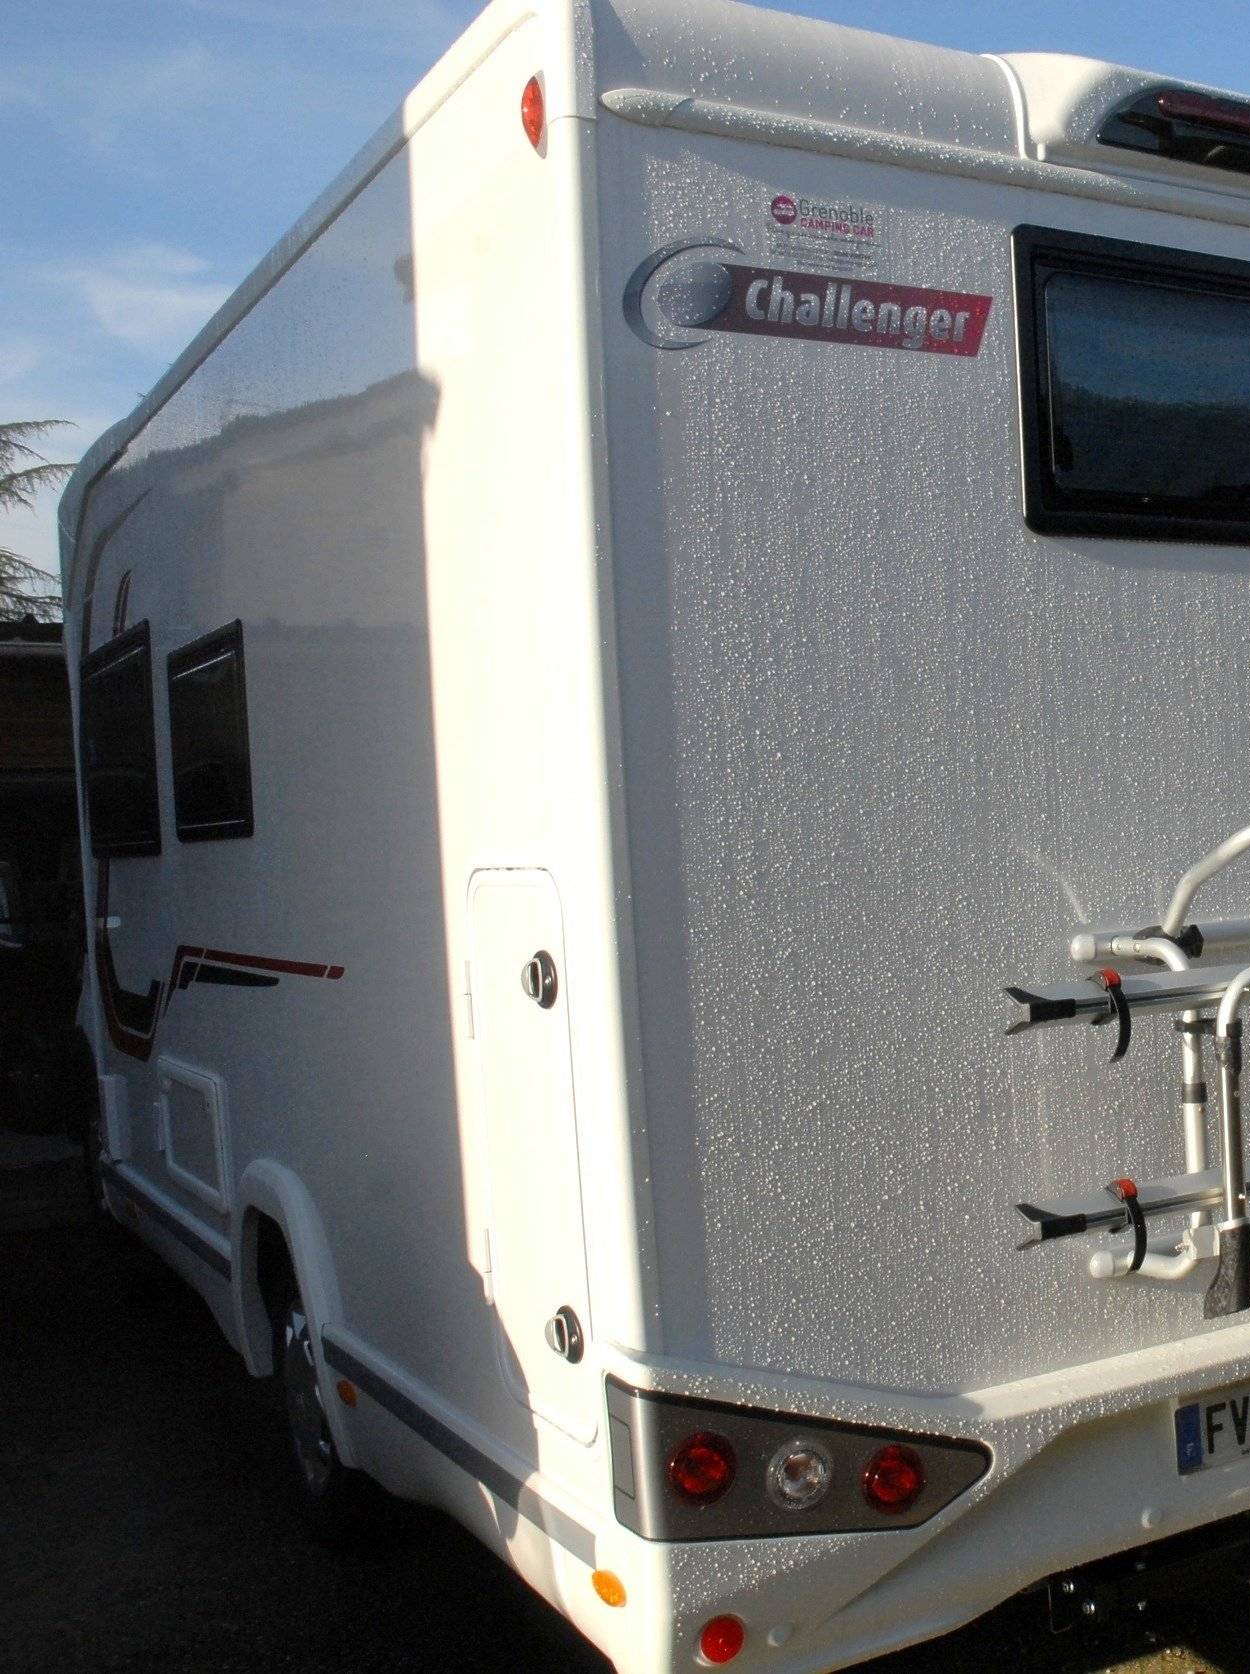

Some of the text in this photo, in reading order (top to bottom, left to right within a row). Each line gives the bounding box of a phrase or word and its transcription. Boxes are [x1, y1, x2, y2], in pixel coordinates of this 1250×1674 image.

[800, 199, 874, 225] Grenoble
[800, 218, 850, 235] CAMPING
[853, 225, 874, 238] CAR
[745, 275, 970, 349] Challenger
